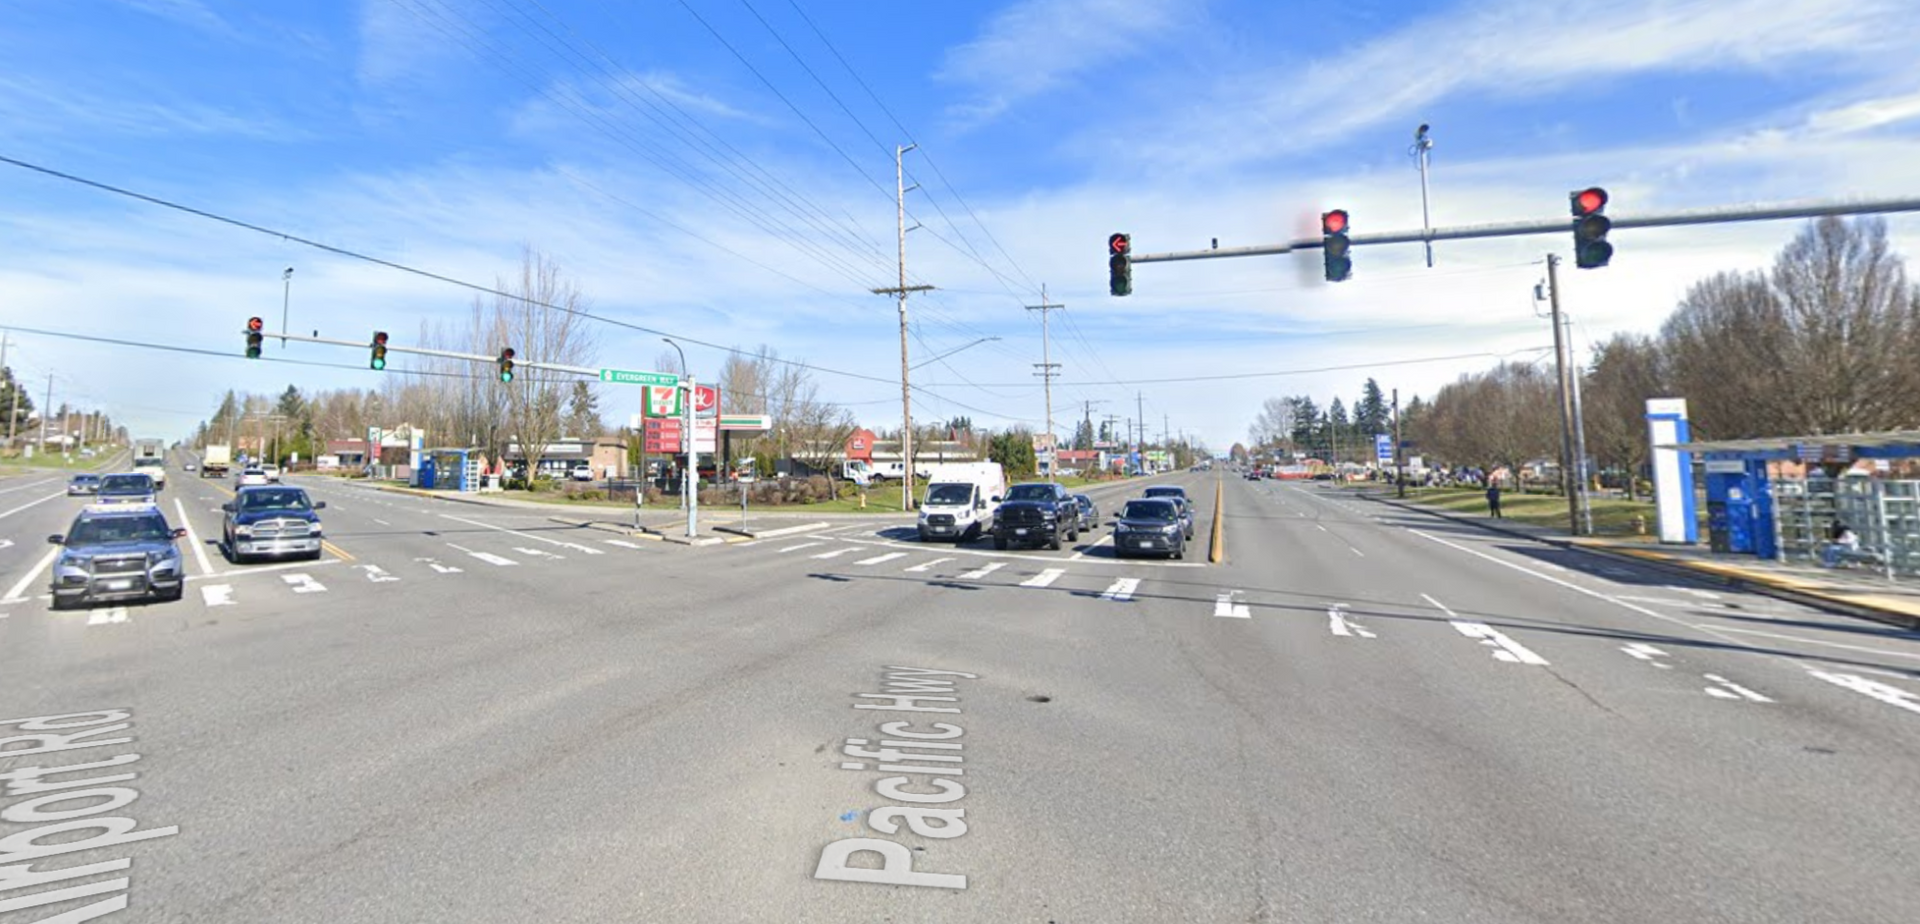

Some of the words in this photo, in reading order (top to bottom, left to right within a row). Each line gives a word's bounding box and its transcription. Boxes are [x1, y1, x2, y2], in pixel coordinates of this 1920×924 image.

[616, 372, 657, 383] EVERGREEN
[660, 376, 674, 385] WAY
[654, 387, 673, 414] 7
